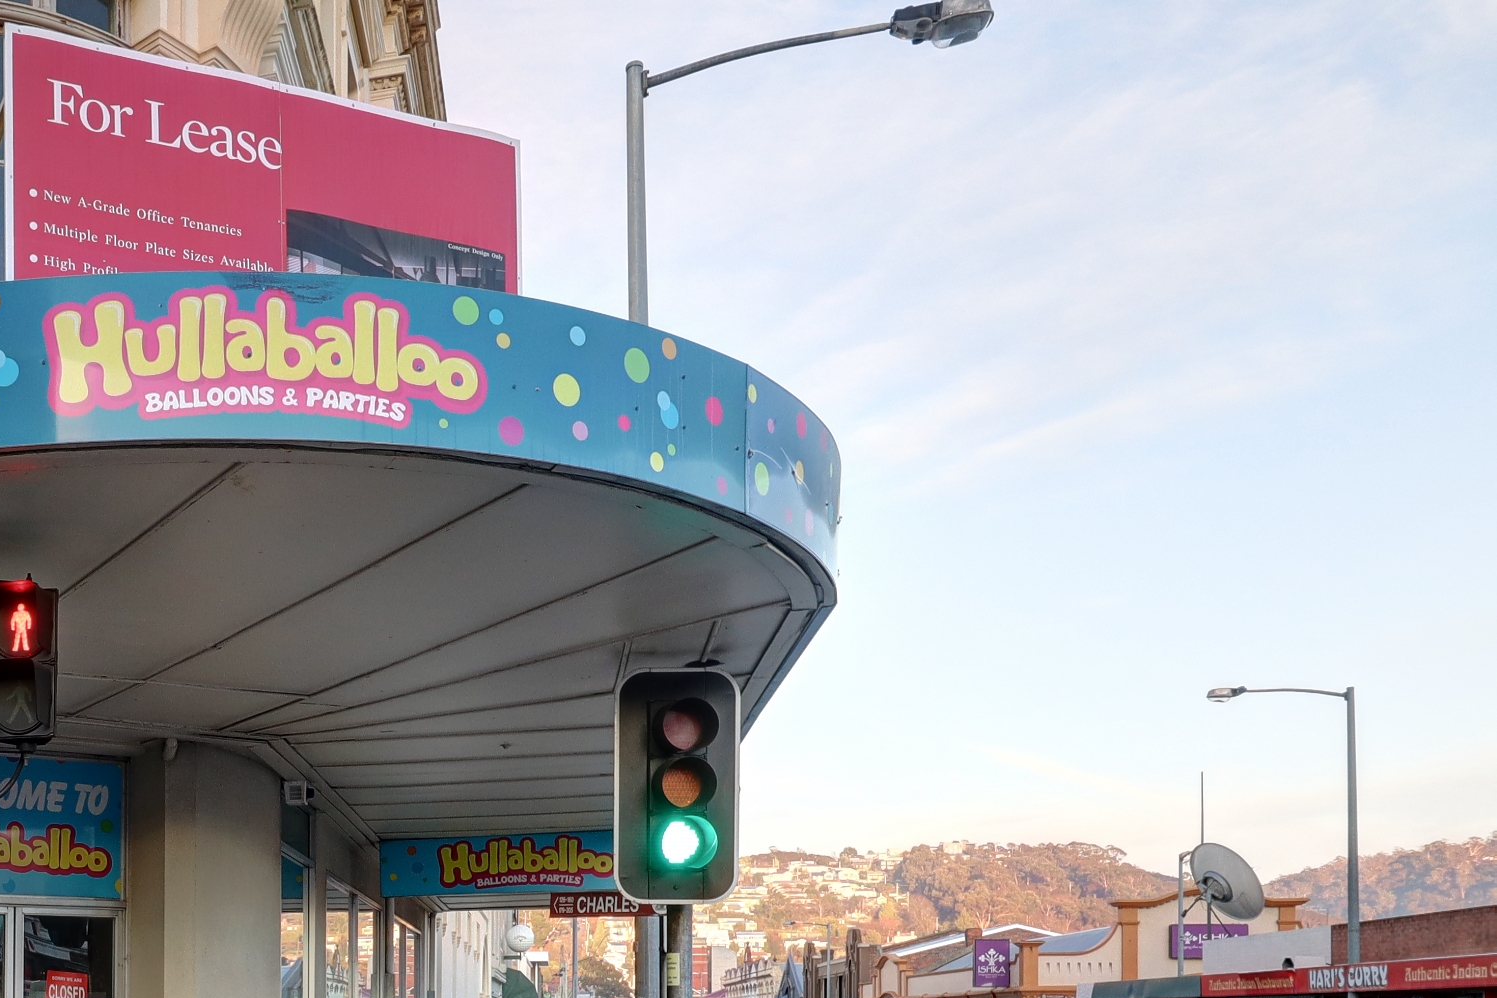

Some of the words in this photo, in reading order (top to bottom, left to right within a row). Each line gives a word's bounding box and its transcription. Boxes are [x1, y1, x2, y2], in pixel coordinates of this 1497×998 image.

[46, 78, 134, 137] For
[144, 99, 283, 170] Lease
[43, 189, 72, 204] New
[78, 197, 131, 217] A-Grade
[137, 208, 175, 225] Office
[180, 216, 243, 237] Tenancies
[43, 222, 99, 243] Multiple
[104, 234, 139, 251] Floor
[145, 242, 177, 258] Plate
[182, 248, 215, 264] Sizes
[220, 254, 274, 272] Available
[447, 242, 471, 254] Concept
[472, 247, 490, 258] Design
[491, 252, 504, 262] Only
[43, 255, 76, 272] High
[82, 261, 122, 274] Profil
[53, 293, 479, 403] Hullaballoo
[144, 385, 275, 414] BALLOONS
[282, 388, 299, 407] &
[305, 387, 407, 421] PARTIES
[74, 783, 109, 816] TO
[440, 837, 613, 883] Hullaballoo
[476, 874, 528, 887] BALLOONS
[530, 875, 537, 883] &
[539, 873, 582, 885] PARTIES
[576, 896, 639, 914] CHARLES
[977, 965, 1006, 974] ISHKA
[1257, 976, 1294, 989] Restaurant
[1309, 967, 1345, 989] HARI'S
[1348, 965, 1388, 988] CURRY
[1405, 965, 1451, 982] Authentic
[1452, 963, 1488, 979] Indian
